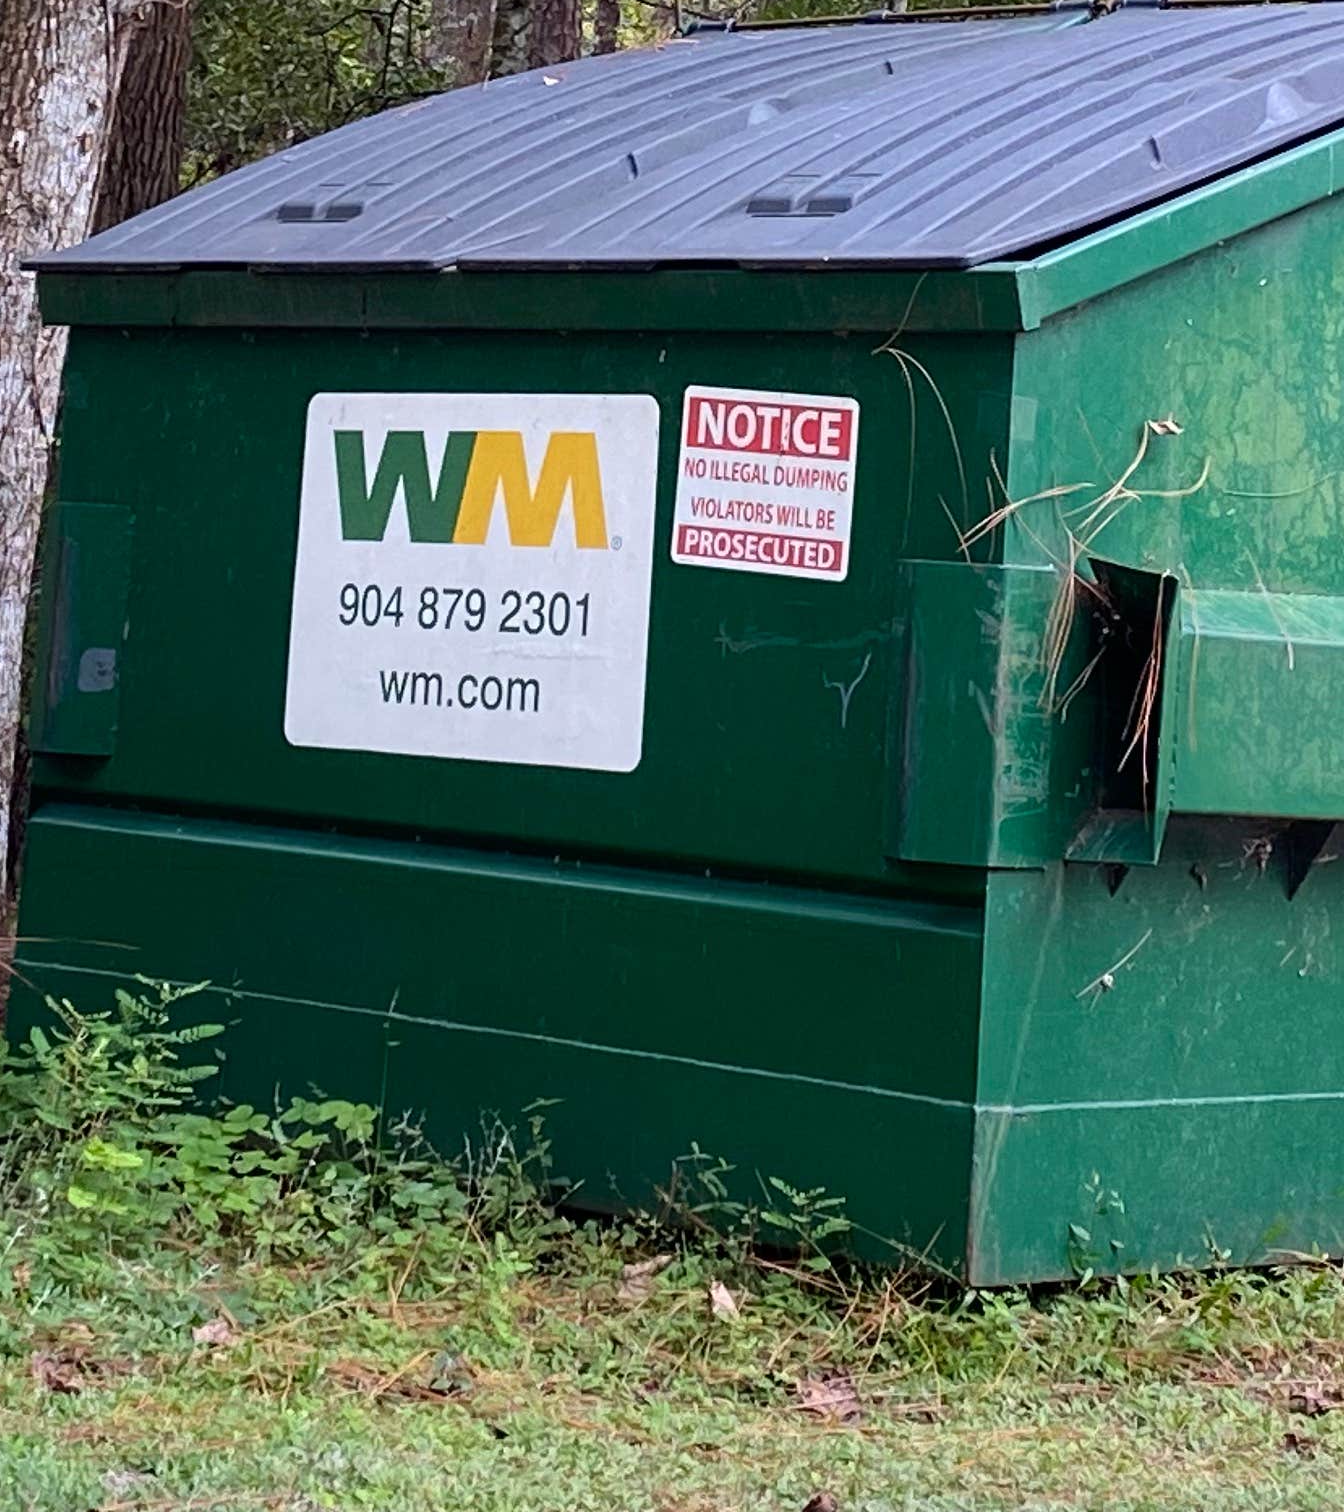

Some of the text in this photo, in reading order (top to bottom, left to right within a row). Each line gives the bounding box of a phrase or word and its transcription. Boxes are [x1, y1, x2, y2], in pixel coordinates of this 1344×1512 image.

[697, 401, 843, 456] NOTICE
[334, 430, 609, 550] WM
[684, 457, 849, 493] NO ILLEGAL DUMPING
[690, 495, 836, 531] VIOLATORS WILL BE
[683, 528, 836, 569] PROSECUTED
[339, 583, 590, 637] 904 879 2301
[379, 670, 540, 713] wm.com
